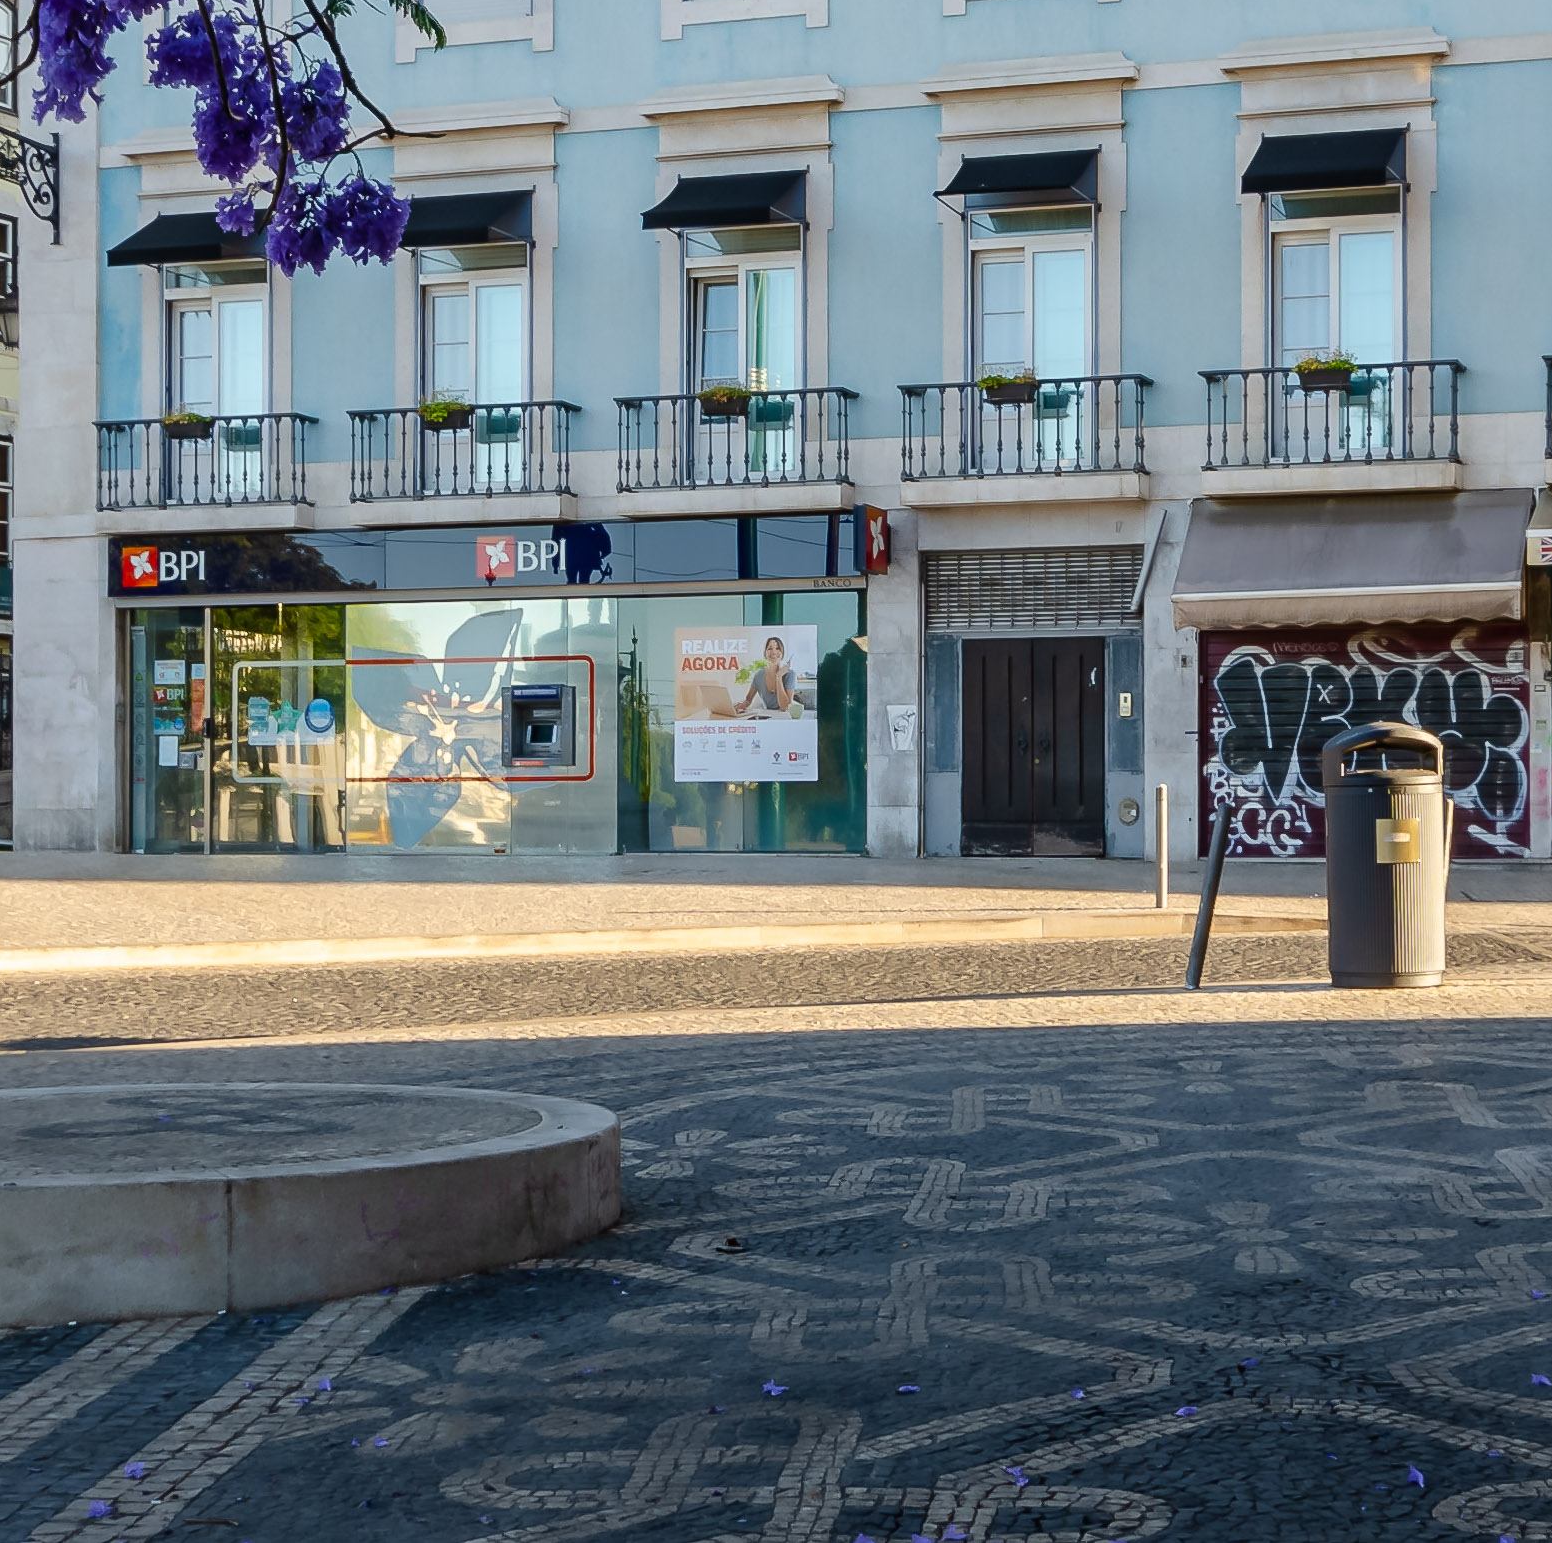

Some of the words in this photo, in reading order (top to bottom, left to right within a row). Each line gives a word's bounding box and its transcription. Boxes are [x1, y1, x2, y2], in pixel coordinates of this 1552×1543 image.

[516, 538, 567, 572] BPI
[159, 550, 205, 582] BPI
[813, 579, 852, 588] BANCO
[681, 639, 748, 655] REALIZE
[681, 656, 740, 672] AGORA
[166, 688, 185, 701] BPI
